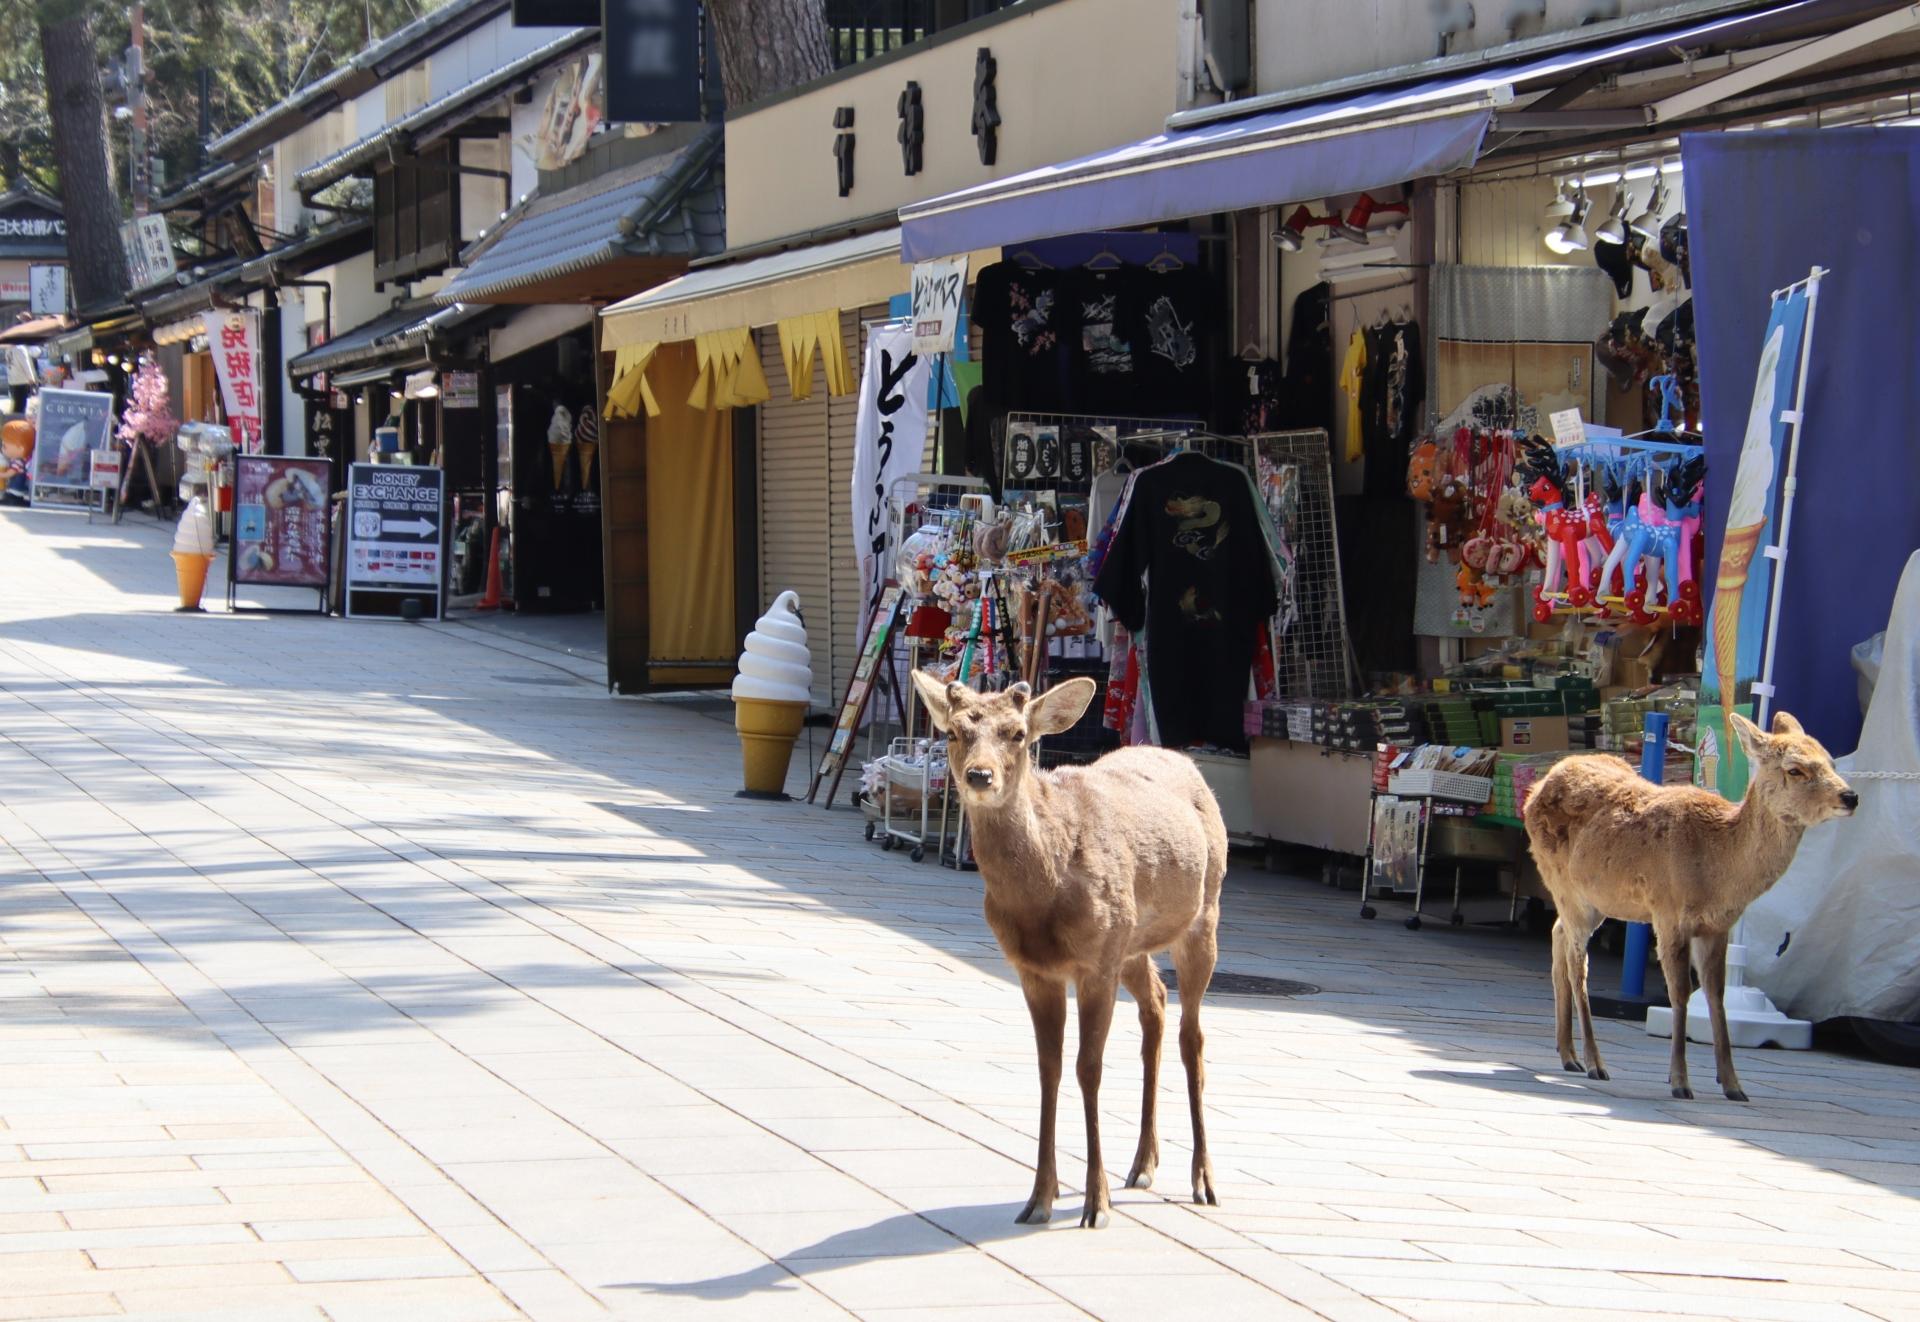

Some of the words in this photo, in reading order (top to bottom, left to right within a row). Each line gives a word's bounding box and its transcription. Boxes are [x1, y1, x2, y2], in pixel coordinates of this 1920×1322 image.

[46, 404, 105, 417] CREMIA
[372, 472, 420, 486] MONEY
[354, 485, 438, 502] EXCHANGE
